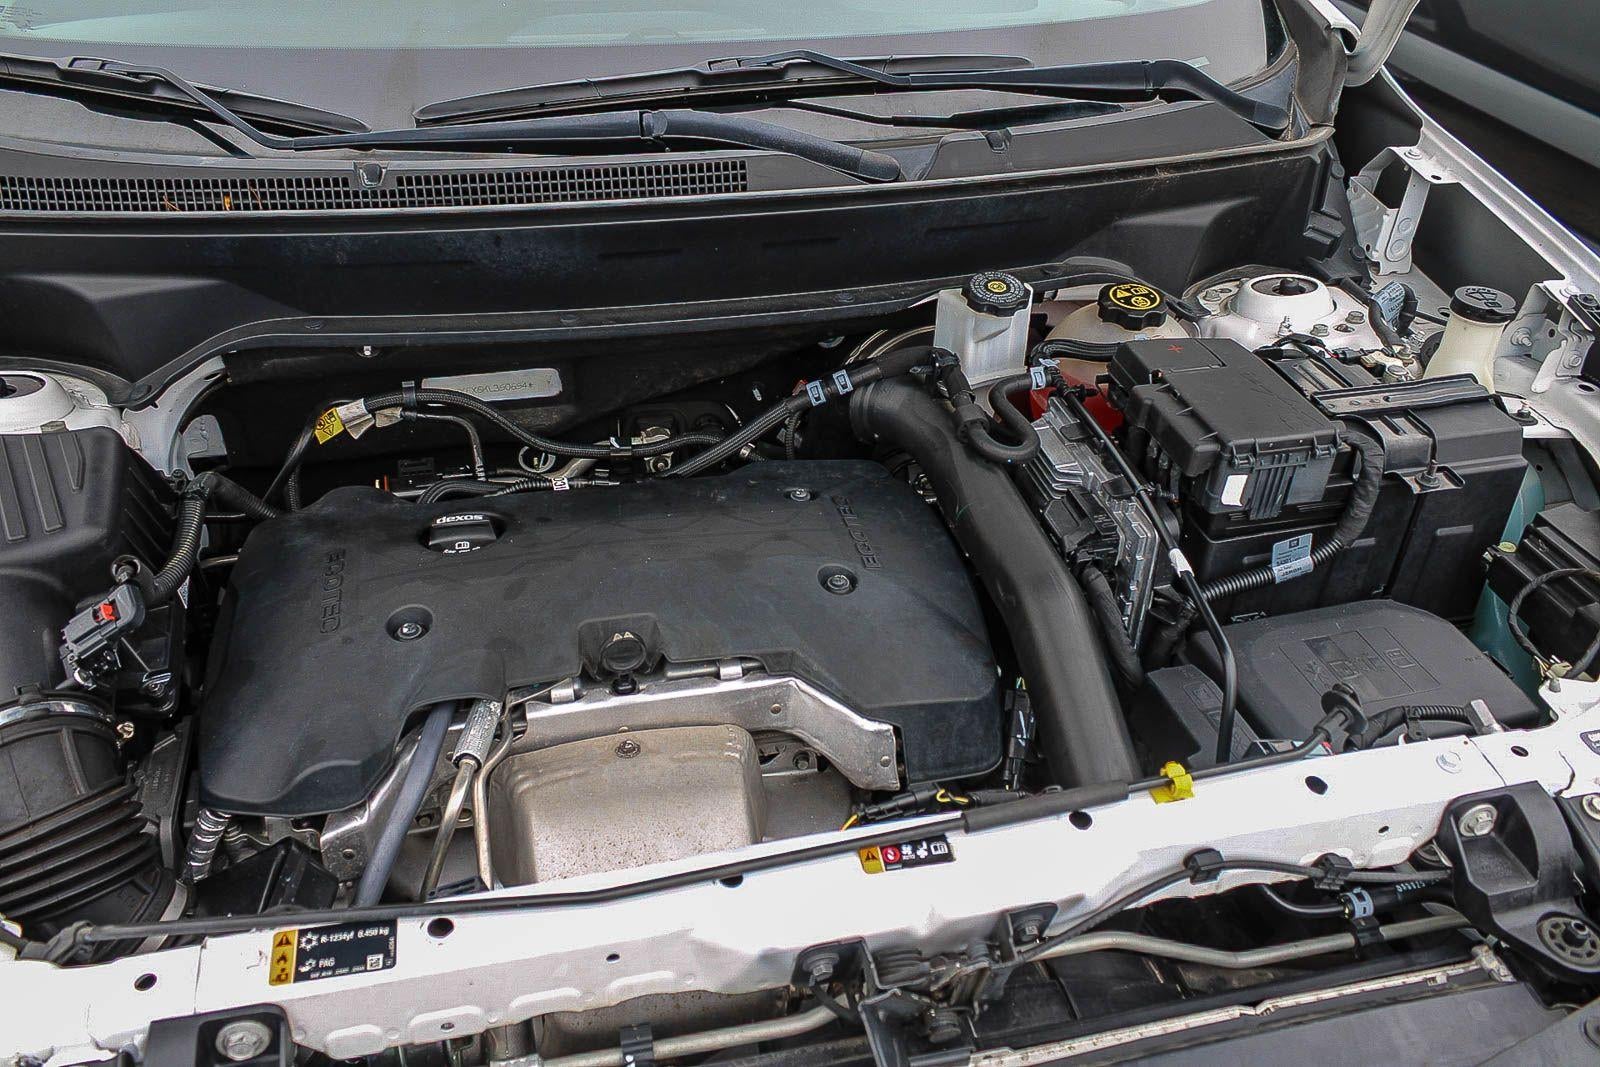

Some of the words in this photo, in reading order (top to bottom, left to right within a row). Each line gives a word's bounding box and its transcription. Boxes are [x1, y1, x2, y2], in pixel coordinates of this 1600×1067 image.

[436, 514, 483, 524] dexos
[320, 548, 346, 634] ECOTEC
[379, 926, 390, 936] kg
[318, 957, 336, 968] PAG
